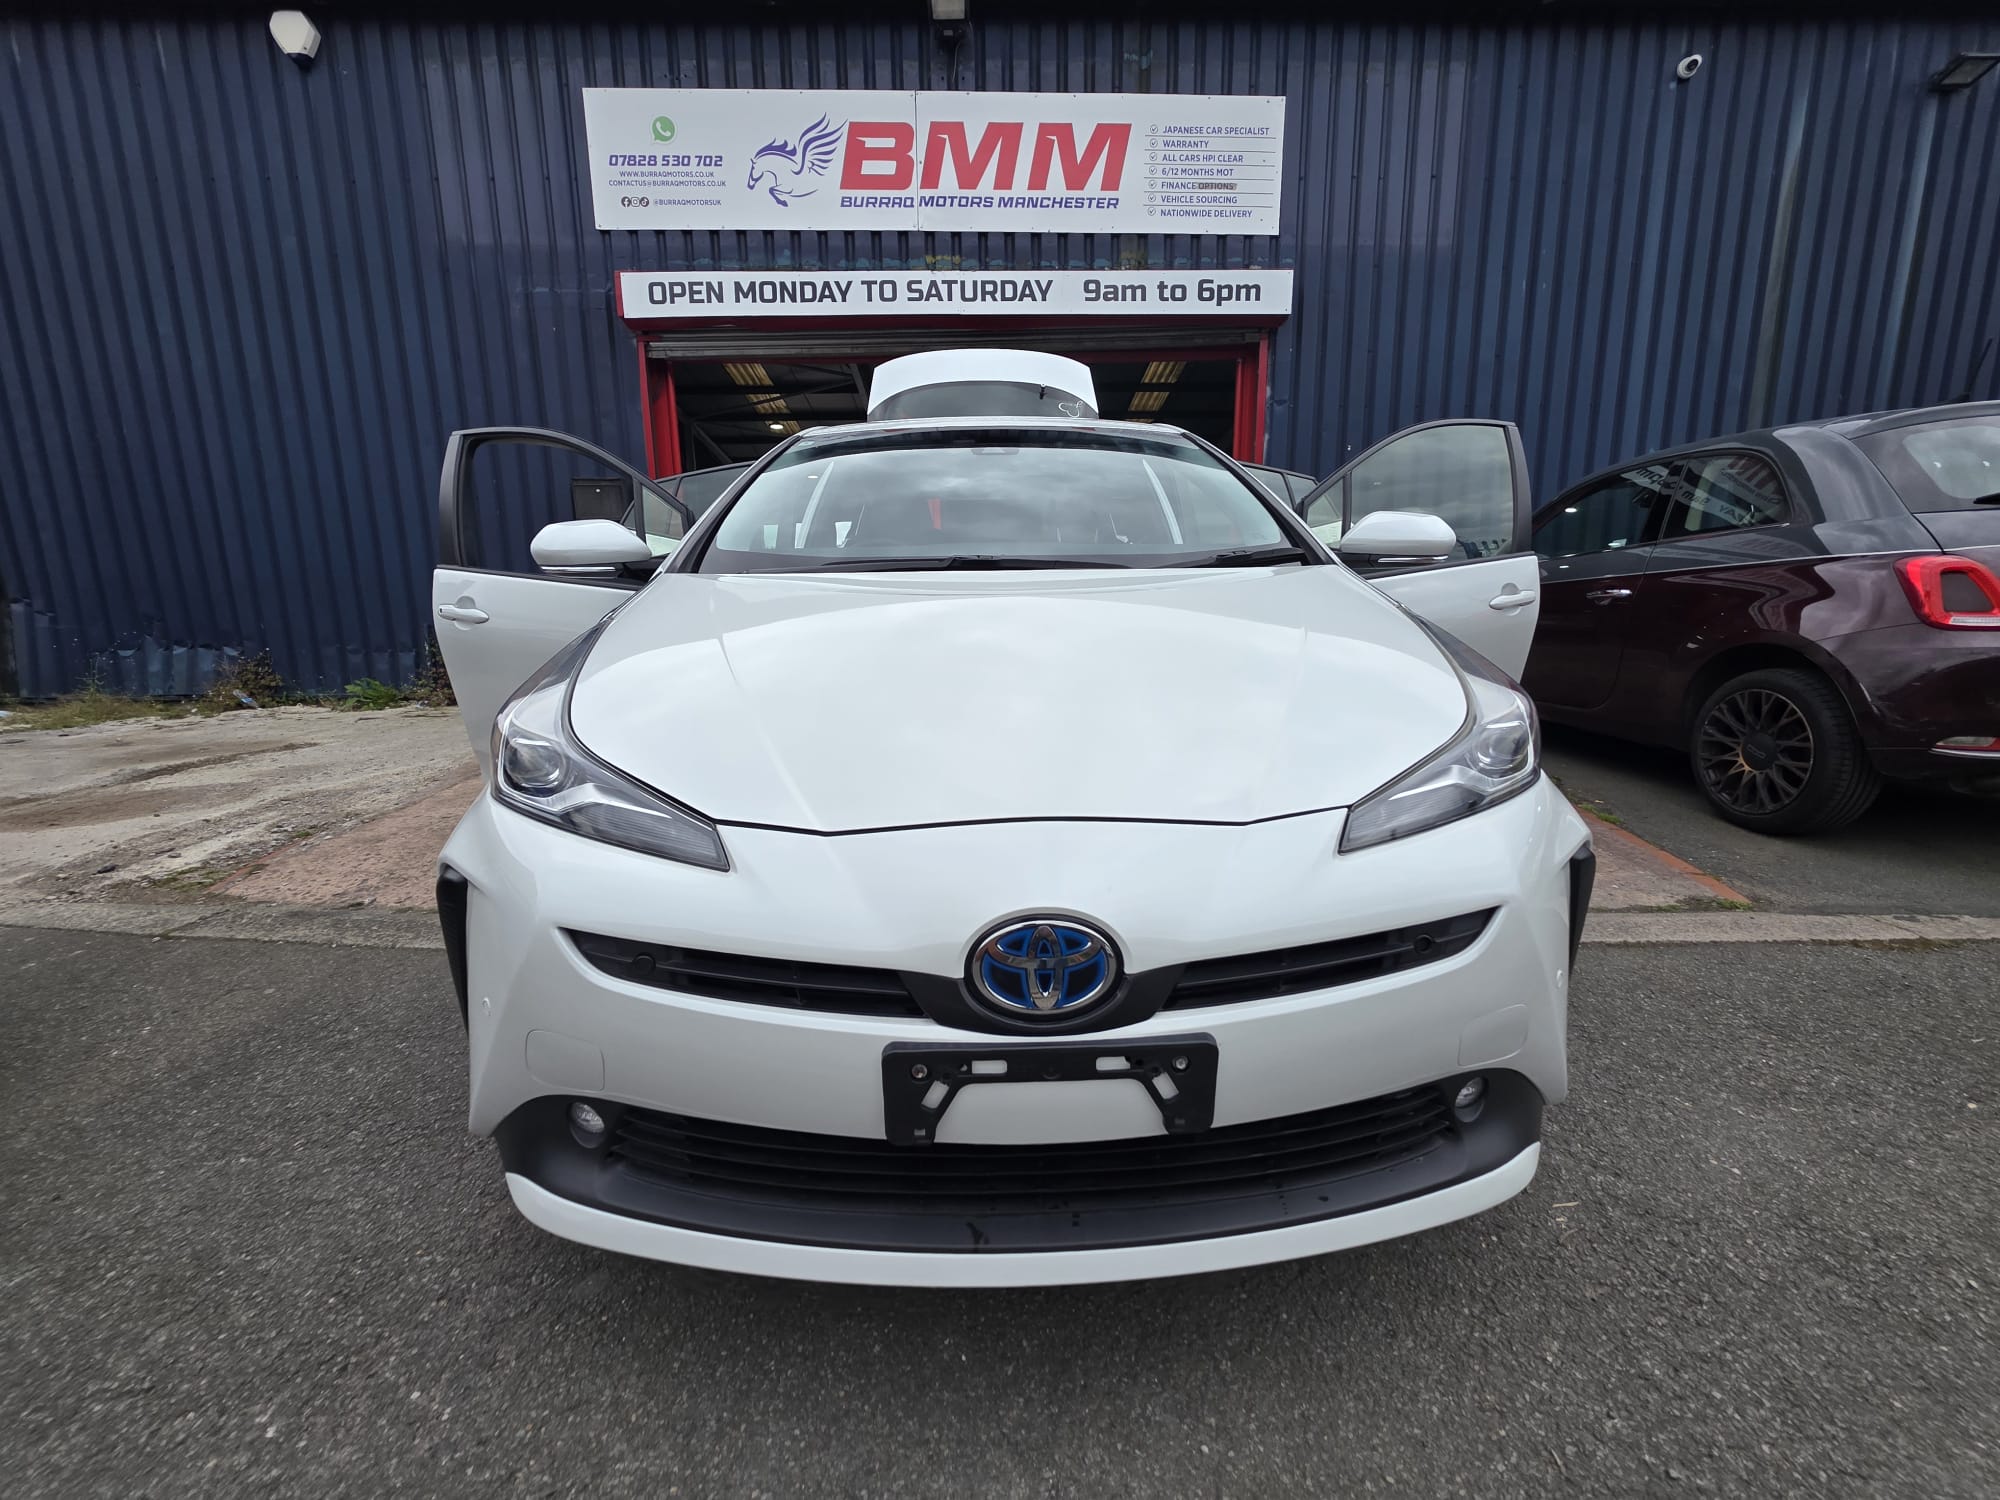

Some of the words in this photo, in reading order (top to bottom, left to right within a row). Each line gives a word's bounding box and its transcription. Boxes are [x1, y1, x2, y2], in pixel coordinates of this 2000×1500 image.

[1162, 126, 1204, 135] JAPANESE
[1205, 126, 1223, 135] CAR
[1224, 126, 1270, 136] SPECIALIST
[1162, 140, 1209, 149] WARRANTY
[608, 154, 658, 167] 07828
[661, 154, 691, 167] 530
[694, 155, 723, 167] 702
[840, 121, 1132, 191] BMM
[1162, 154, 1178, 162] ALL
[1180, 154, 1201, 163] CARS
[1202, 154, 1216, 163] HPI
[1217, 154, 1244, 163] CLEAR
[619, 170, 715, 178] WWW.BURRAQMOTORS.CO.UK
[1161, 167, 1179, 176] 6/12
[1180, 168, 1215, 177] MONTHS
[1216, 168, 1234, 177] MOT
[1161, 181, 1196, 190] FINANCE
[1198, 182, 1234, 190] OPTIONS
[653, 198, 722, 206] @BURRAQMOTORSUK
[840, 195, 915, 208] BURRAQ
[918, 195, 994, 208] MOTORS
[997, 196, 1120, 209] MANCHESTER
[1160, 195, 1195, 204] VEHICLE
[1196, 195, 1237, 204] SOURCING
[1160, 208, 1213, 218] NATIONWIDE
[1213, 209, 1253, 218] DELIVERY
[648, 281, 724, 305] OPEN
[734, 280, 853, 304] MONDAY
[861, 280, 897, 303] TO
[906, 279, 1053, 302] SATURDAY
[1083, 278, 1147, 303] 9am
[1157, 280, 1187, 302] to
[1197, 279, 1261, 306] 6pm
